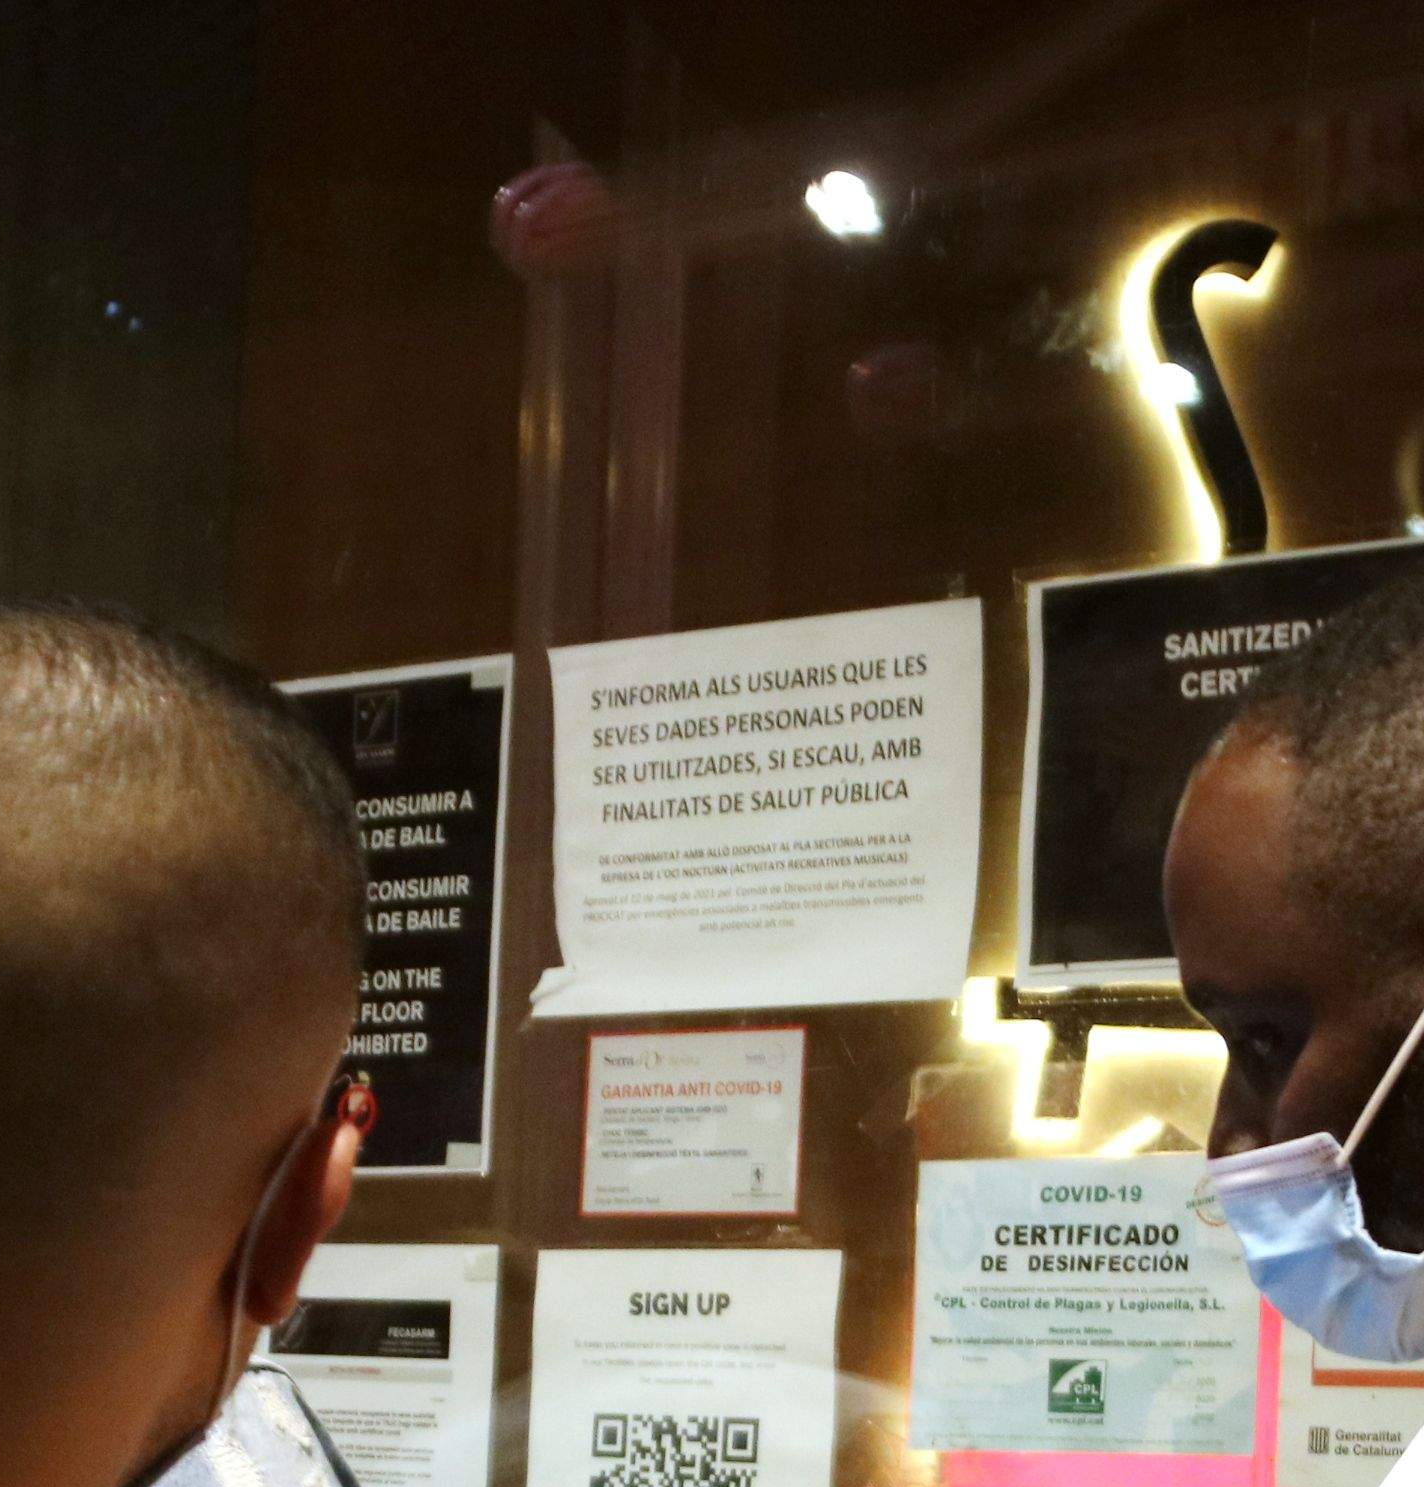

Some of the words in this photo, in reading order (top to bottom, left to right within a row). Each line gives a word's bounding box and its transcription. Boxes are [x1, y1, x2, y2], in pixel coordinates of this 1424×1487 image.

[1164, 620, 1311, 660] SANITIZED
[590, 681, 700, 711] S'INFORMA
[706, 675, 741, 698] ALS
[748, 666, 837, 693] USUARIS
[842, 659, 887, 686] QUE
[894, 654, 928, 678] LES
[1181, 666, 1260, 698] CERT
[592, 725, 650, 748] SEVES
[656, 718, 719, 742] DADES
[726, 709, 844, 734] PERSONALS
[850, 696, 924, 722] PODEN
[592, 765, 626, 786] SER
[633, 751, 762, 783] UTILITZADES,
[768, 750, 786, 771] SI
[793, 742, 865, 767] ESCAU,
[871, 736, 922, 762] AMB
[355, 792, 458, 819] CONSUMIR
[459, 791, 474, 811] A
[602, 796, 711, 823] FINALITATS
[719, 794, 744, 814] DE
[751, 787, 815, 811] SALUT
[820, 777, 908, 806] PÚBLICA
[372, 828, 397, 849] DE
[400, 823, 445, 848] BALL
[366, 875, 469, 902] CONSUMIR
[378, 913, 402, 932] DE
[407, 907, 461, 931] BAILE
[373, 969, 401, 990] ON
[404, 967, 442, 988] THE
[361, 1000, 424, 1023] FLOOR
[342, 1031, 428, 1056] HIBITED
[601, 1082, 674, 1100] GARANTIA
[678, 1081, 710, 1097] ANTI
[715, 1080, 782, 1096] COVID-19
[1040, 1185, 1143, 1204] COVID-19
[994, 1224, 1180, 1247] CERTIFICADO
[981, 1256, 1007, 1272] DE
[1028, 1251, 1189, 1273] DESINFECCIÓN
[629, 1292, 689, 1316] SIGN
[696, 1292, 731, 1316] UP
[980, 1297, 1030, 1310] Control
[1034, 1297, 1050, 1310] de
[1054, 1297, 1101, 1313] Plagas
[1106, 1300, 1114, 1313] y
[1335, 1429, 1402, 1442] Generalitat
[1334, 1445, 1349, 1456] de
